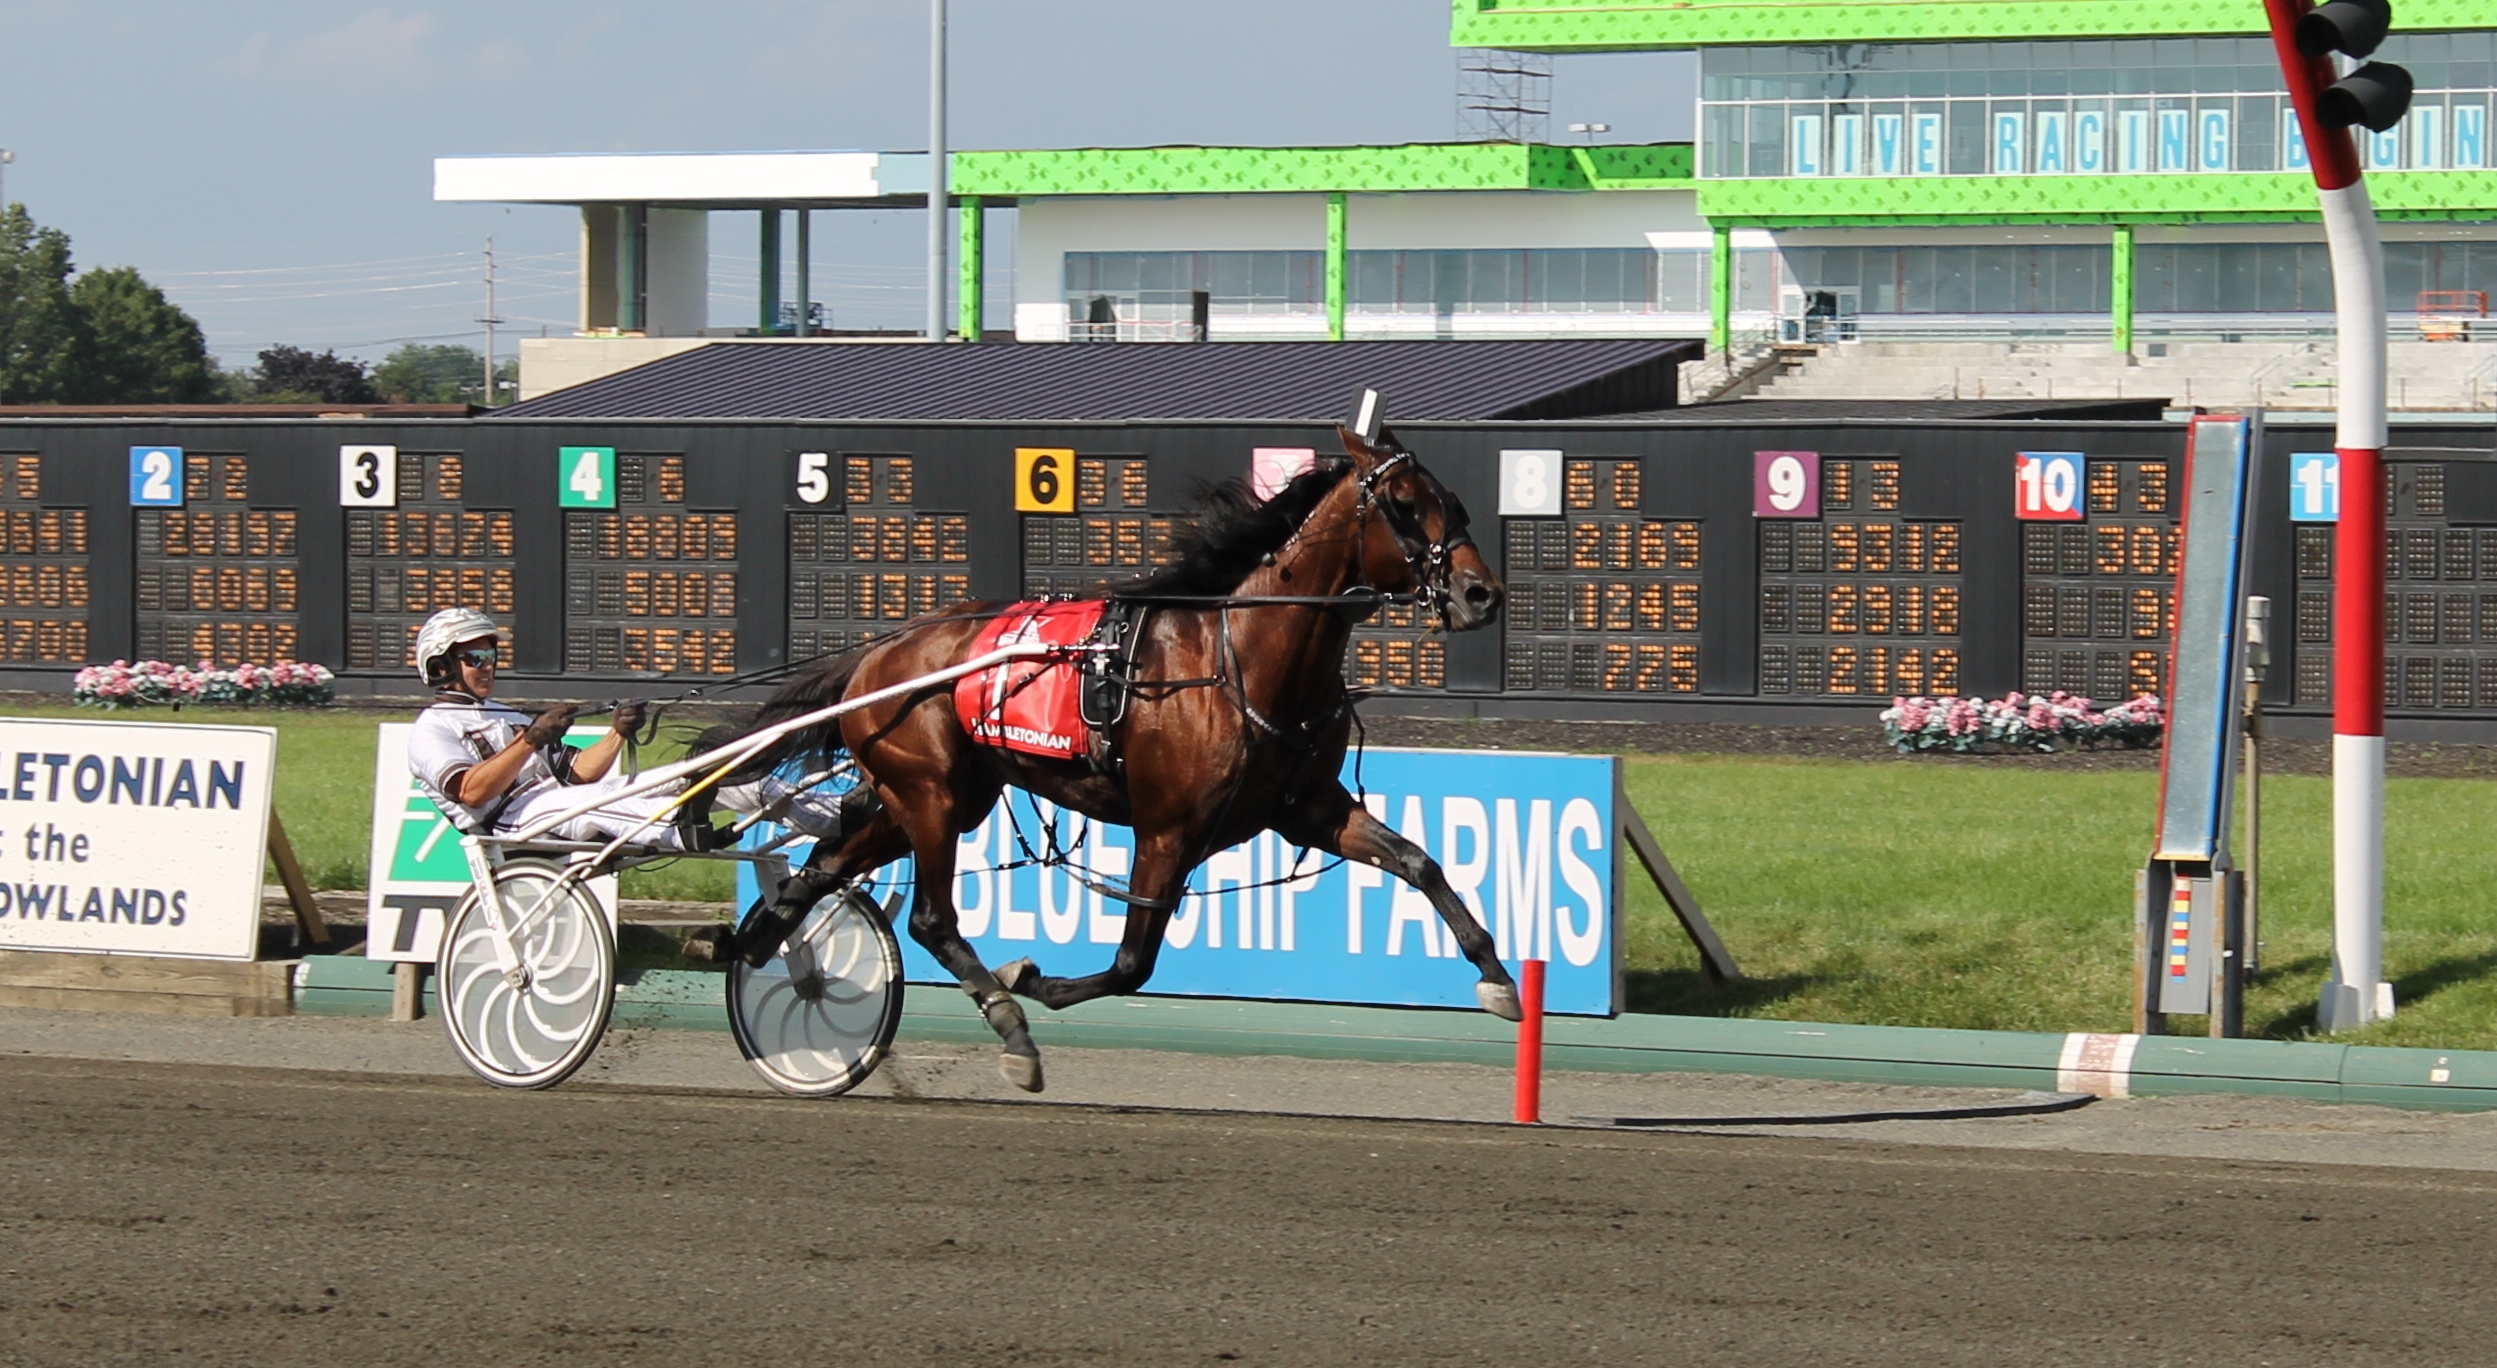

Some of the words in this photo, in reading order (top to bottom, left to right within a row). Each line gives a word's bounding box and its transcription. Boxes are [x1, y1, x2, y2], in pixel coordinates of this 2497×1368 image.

[1800, 116, 1938, 175] LIVE
[2000, 110, 2227, 173] RACING
[2287, 108, 2482, 169] BGIN
[142, 452, 173, 499] 2
[356, 453, 378, 498] 3
[570, 452, 603, 501] 4
[797, 453, 830, 504] 5
[1031, 456, 1057, 504] 6
[1513, 454, 1548, 508] 8
[1768, 456, 1806, 510] 9
[2020, 457, 2076, 512] 10
[852, 516, 967, 560] 3842
[1573, 523, 1699, 568] 2169
[1830, 524, 1959, 571] 9312
[1584, 583, 1698, 630] 1245
[625, 628, 735, 673] 3542
[1604, 643, 1697, 691] 775
[1828, 646, 1959, 698] 2142
[24, 823, 90, 863] the
[1164, 827, 1324, 951] HIP
[1346, 795, 1603, 967] FARMS
